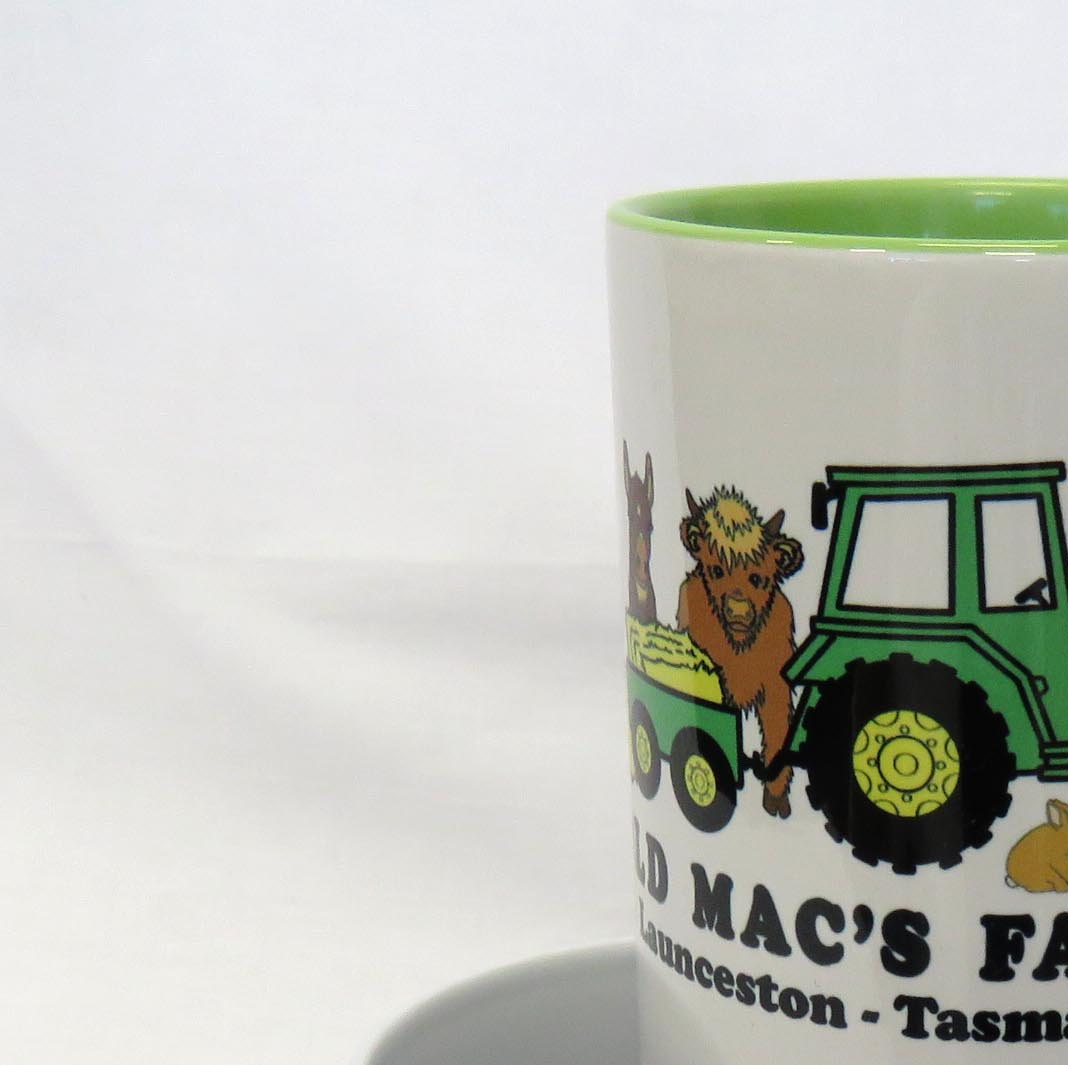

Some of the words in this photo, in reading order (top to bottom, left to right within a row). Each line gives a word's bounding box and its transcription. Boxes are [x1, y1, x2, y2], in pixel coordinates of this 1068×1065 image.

[634, 815, 669, 904] LD
[690, 862, 931, 978] MAC'S
[639, 896, 848, 1030] Launceston
